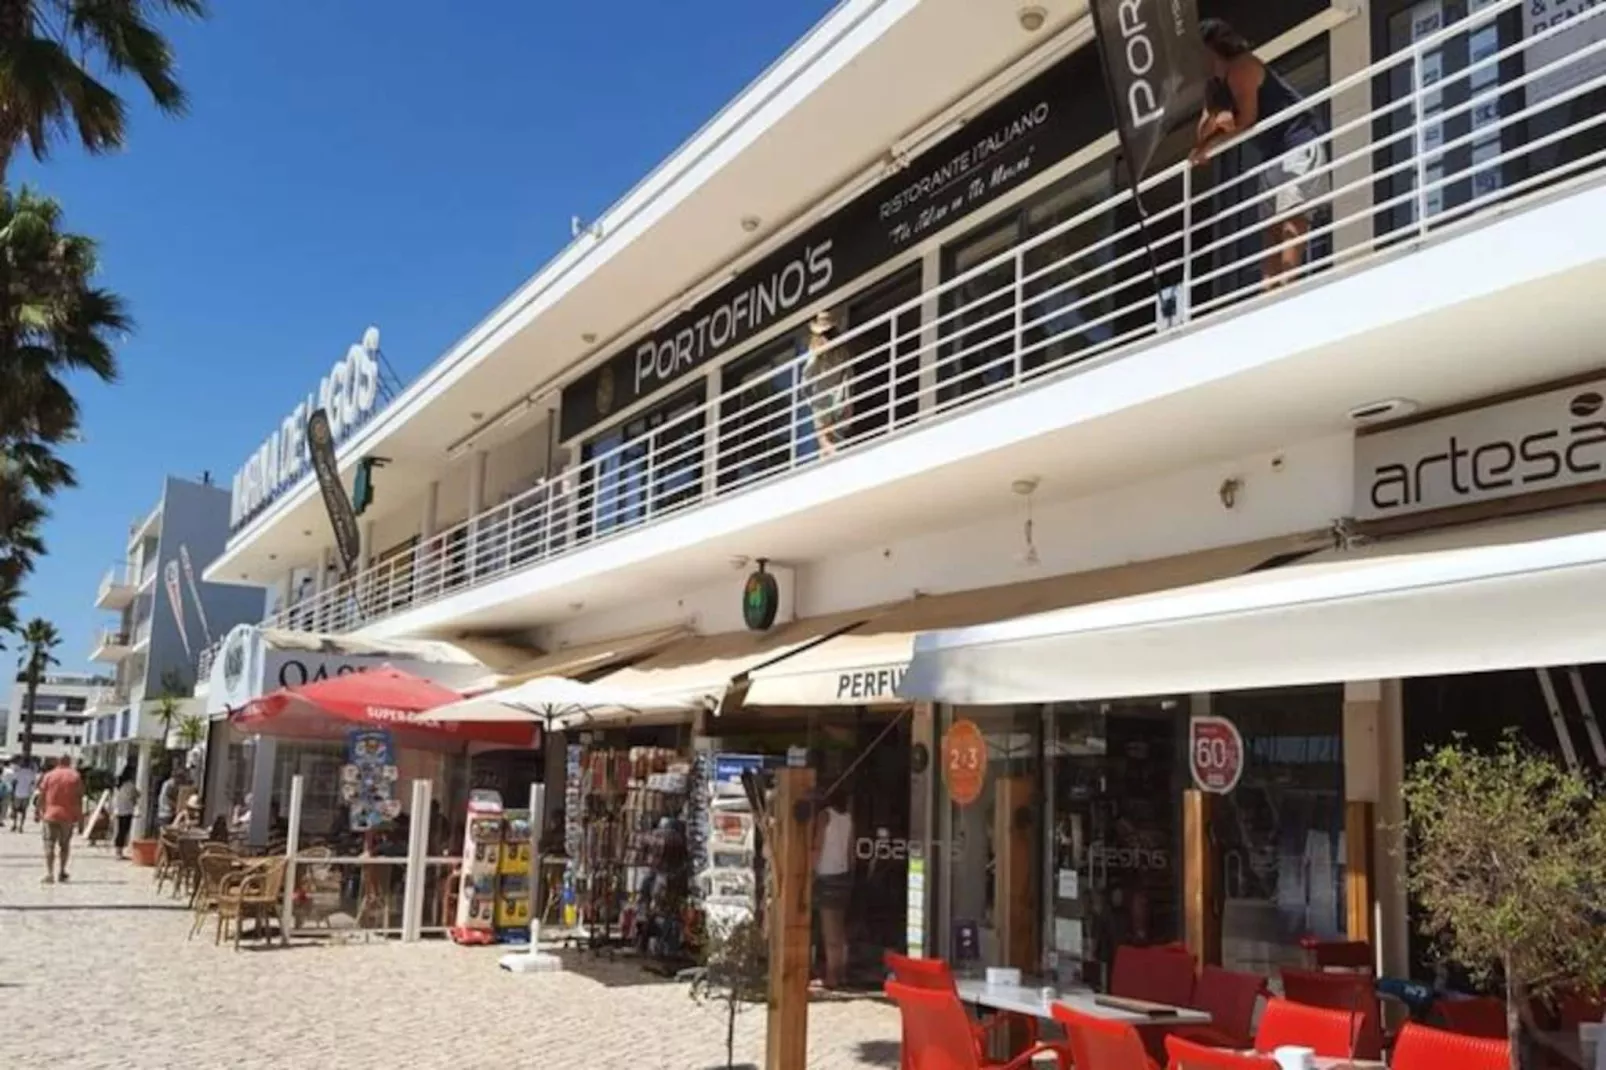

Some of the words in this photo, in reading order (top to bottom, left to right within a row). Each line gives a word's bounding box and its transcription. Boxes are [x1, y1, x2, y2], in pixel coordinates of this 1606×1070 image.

[879, 150, 972, 221] RISTORANTE
[972, 102, 1049, 165] ITALIANO
[634, 239, 833, 395] PORTOFINO'S
[837, 667, 908, 698] PERFU
[1197, 737, 1226, 768] 60
